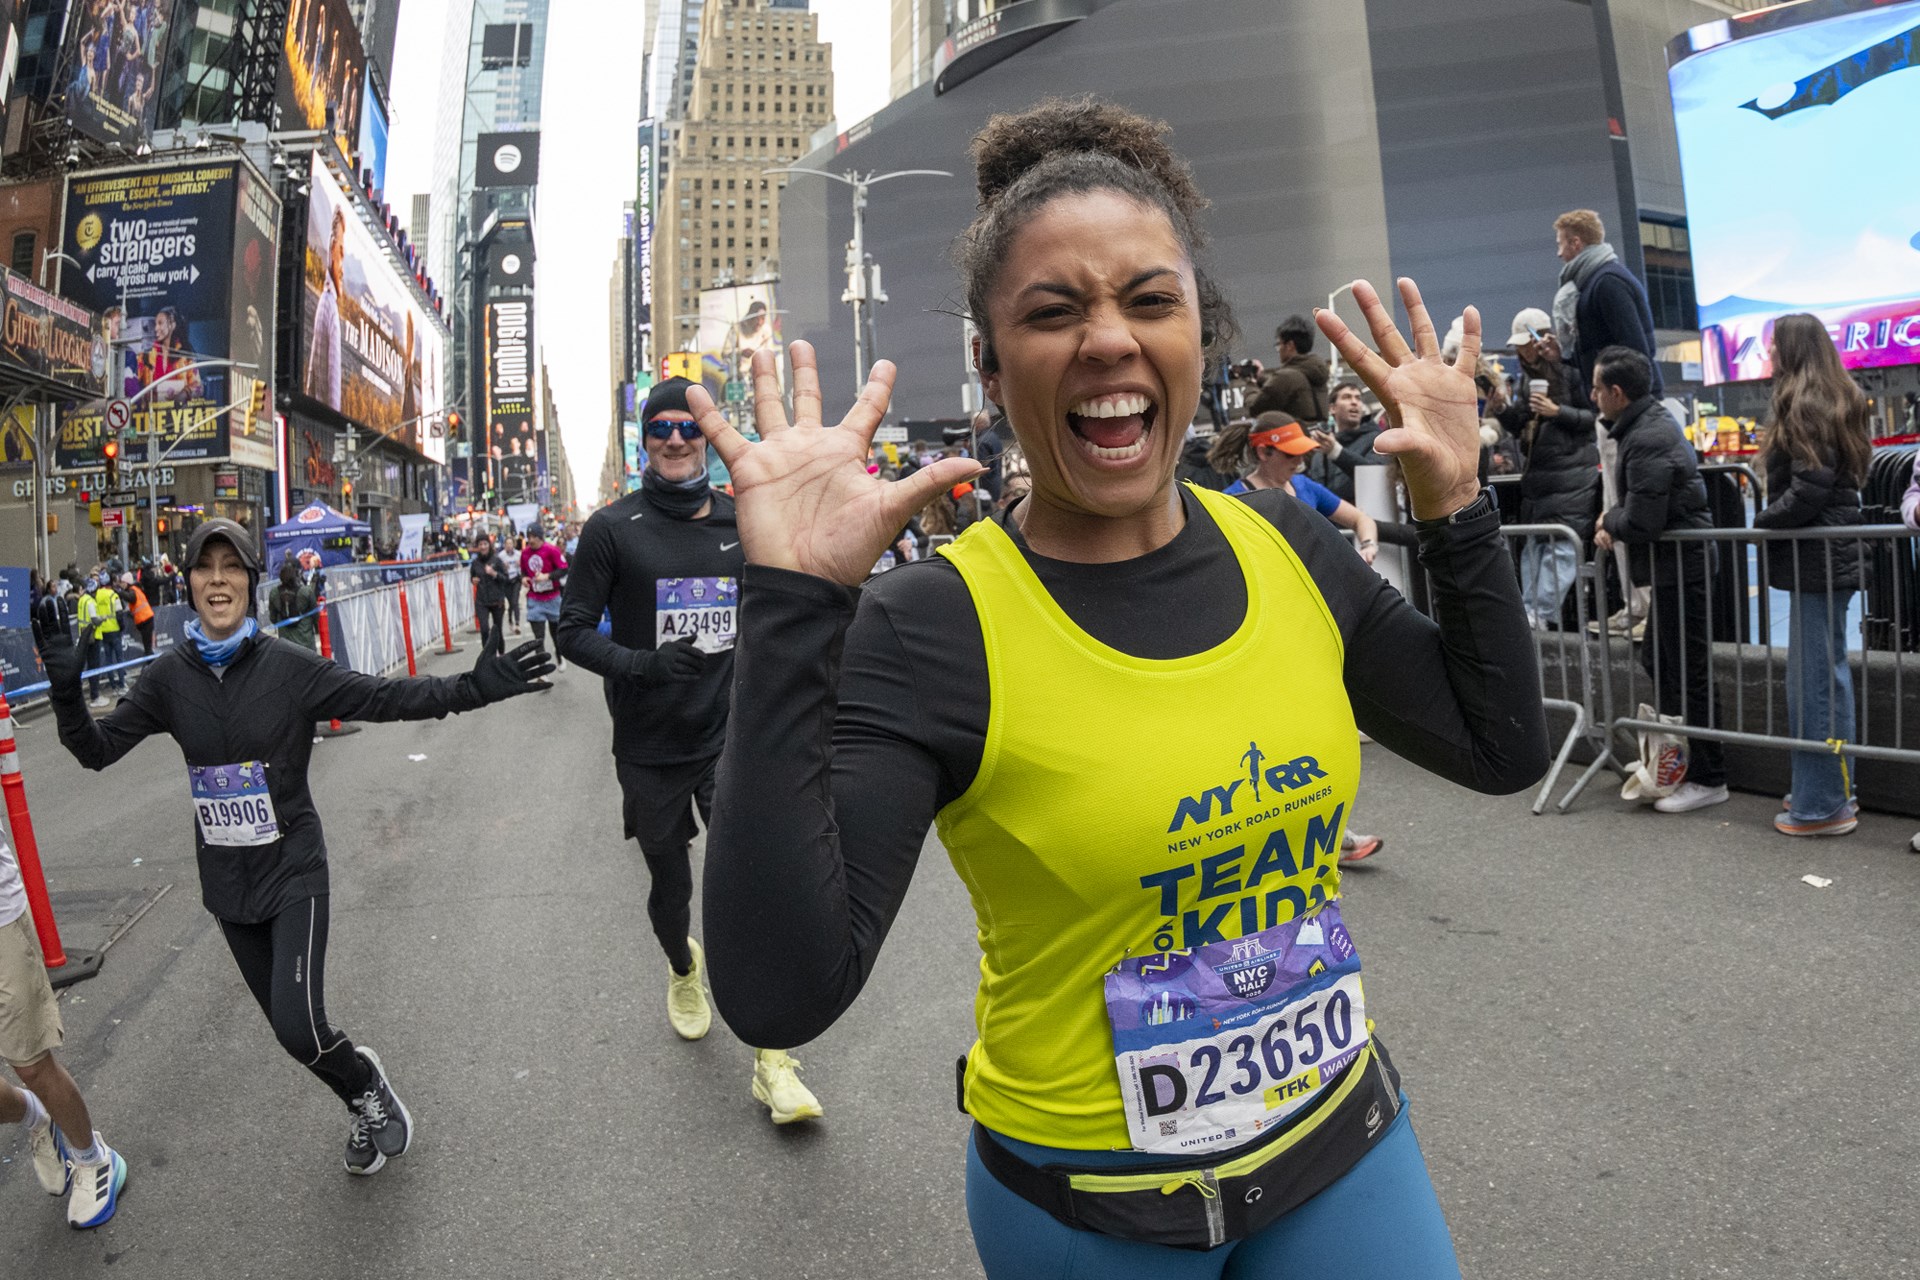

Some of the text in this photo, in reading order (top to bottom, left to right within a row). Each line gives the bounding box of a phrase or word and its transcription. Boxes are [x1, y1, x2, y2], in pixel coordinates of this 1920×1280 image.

[956, 11, 1002, 41] MARRIOTT
[956, 25, 997, 51] MARQUIS
[87, 178, 141, 193] EFFERVESCENT
[142, 176, 160, 187] NEW
[160, 171, 195, 184] MUSICAL
[196, 167, 233, 180] COMEDY!
[85, 191, 128, 206] LAUGHTER,
[129, 186, 161, 200] ESCAPE,
[110, 218, 147, 242] two
[640, 145, 651, 306] GET YOUR AD IN THE GAME
[100, 234, 196, 266] strangers
[96, 265, 119, 280] carry
[128, 261, 149, 275] cake
[116, 266, 189, 288] across new york
[4, 298, 39, 350] GIFTS
[47, 315, 92, 371] LUGGAGE
[345, 320, 359, 350] THE
[63, 415, 104, 443] BEST
[171, 406, 218, 434] YEAR
[1, 602, 9, 613] 2
[661, 610, 731, 636] A23499
[199, 798, 269, 827] B19906
[1167, 785, 1333, 854] NEW YORK ROAD RUNNERS
[1139, 801, 1345, 917] TEAM
[1219, 952, 1277, 972] UNITED AIRLINES
[1233, 965, 1268, 985] NYC
[1238, 977, 1267, 994] HALF
[1223, 1016, 1236, 1026] NEW
[1236, 1011, 1251, 1021] YORK
[1251, 1006, 1266, 1016] ROAD
[1274, 1074, 1311, 1101] TFK
[1180, 1133, 1222, 1147] UNITED
